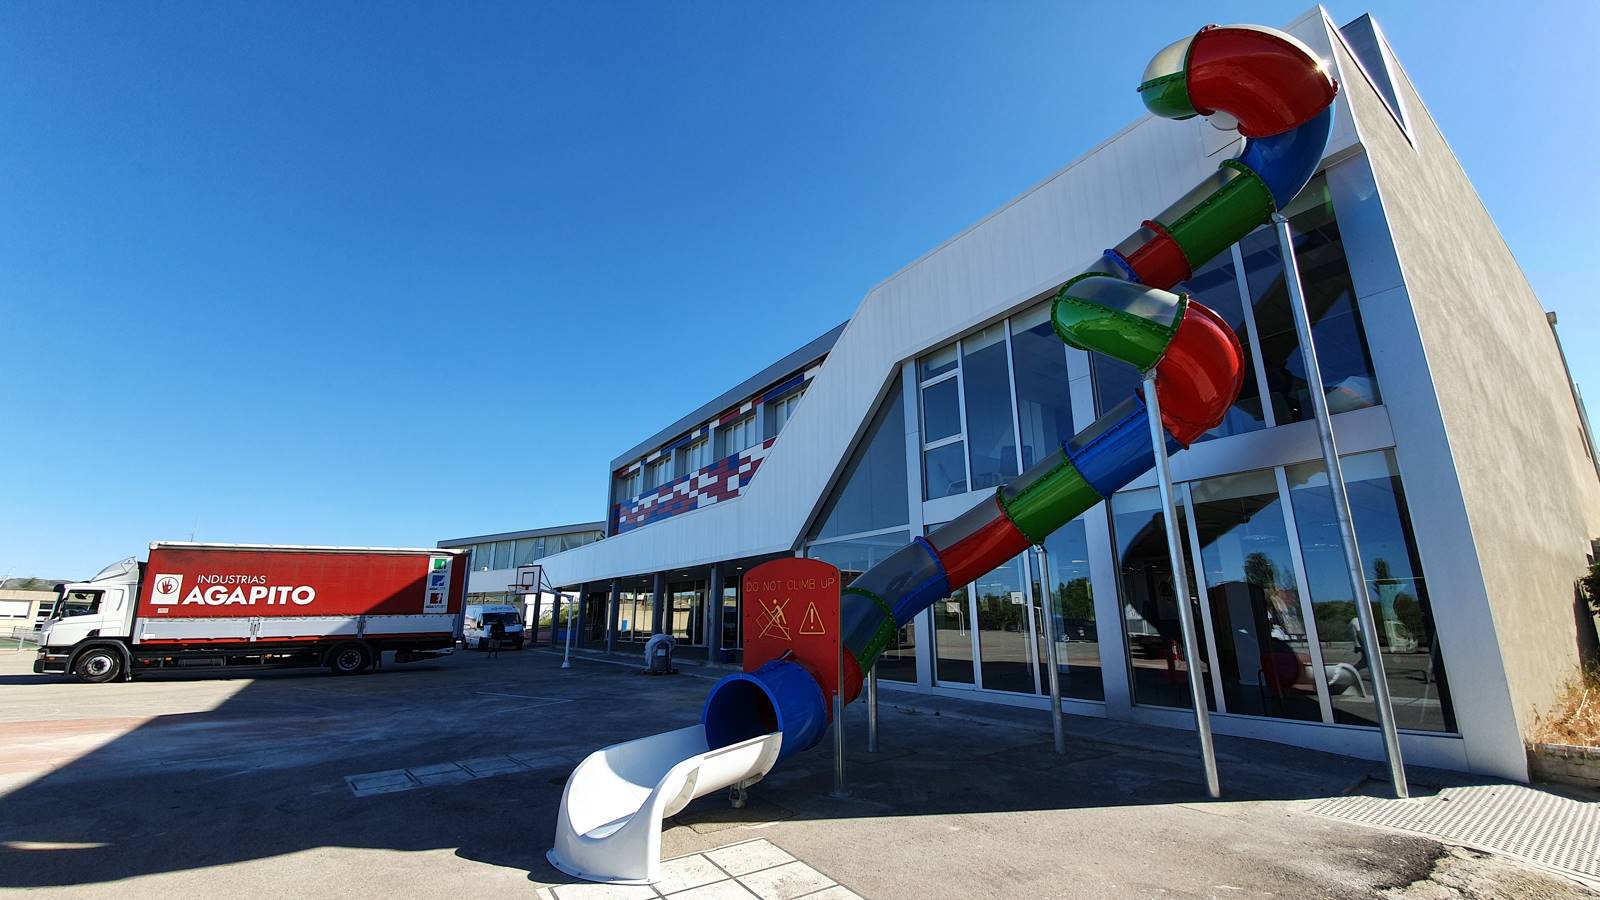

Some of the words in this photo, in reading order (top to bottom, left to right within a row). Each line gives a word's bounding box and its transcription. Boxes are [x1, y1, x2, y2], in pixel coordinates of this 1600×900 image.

[197, 575, 266, 584] INDUSTRIAS
[746, 582, 759, 592] DO
[763, 581, 784, 591] NOT
[787, 579, 816, 590] CLIMB
[820, 577, 835, 588] UP
[181, 586, 316, 605] AGAPITO
